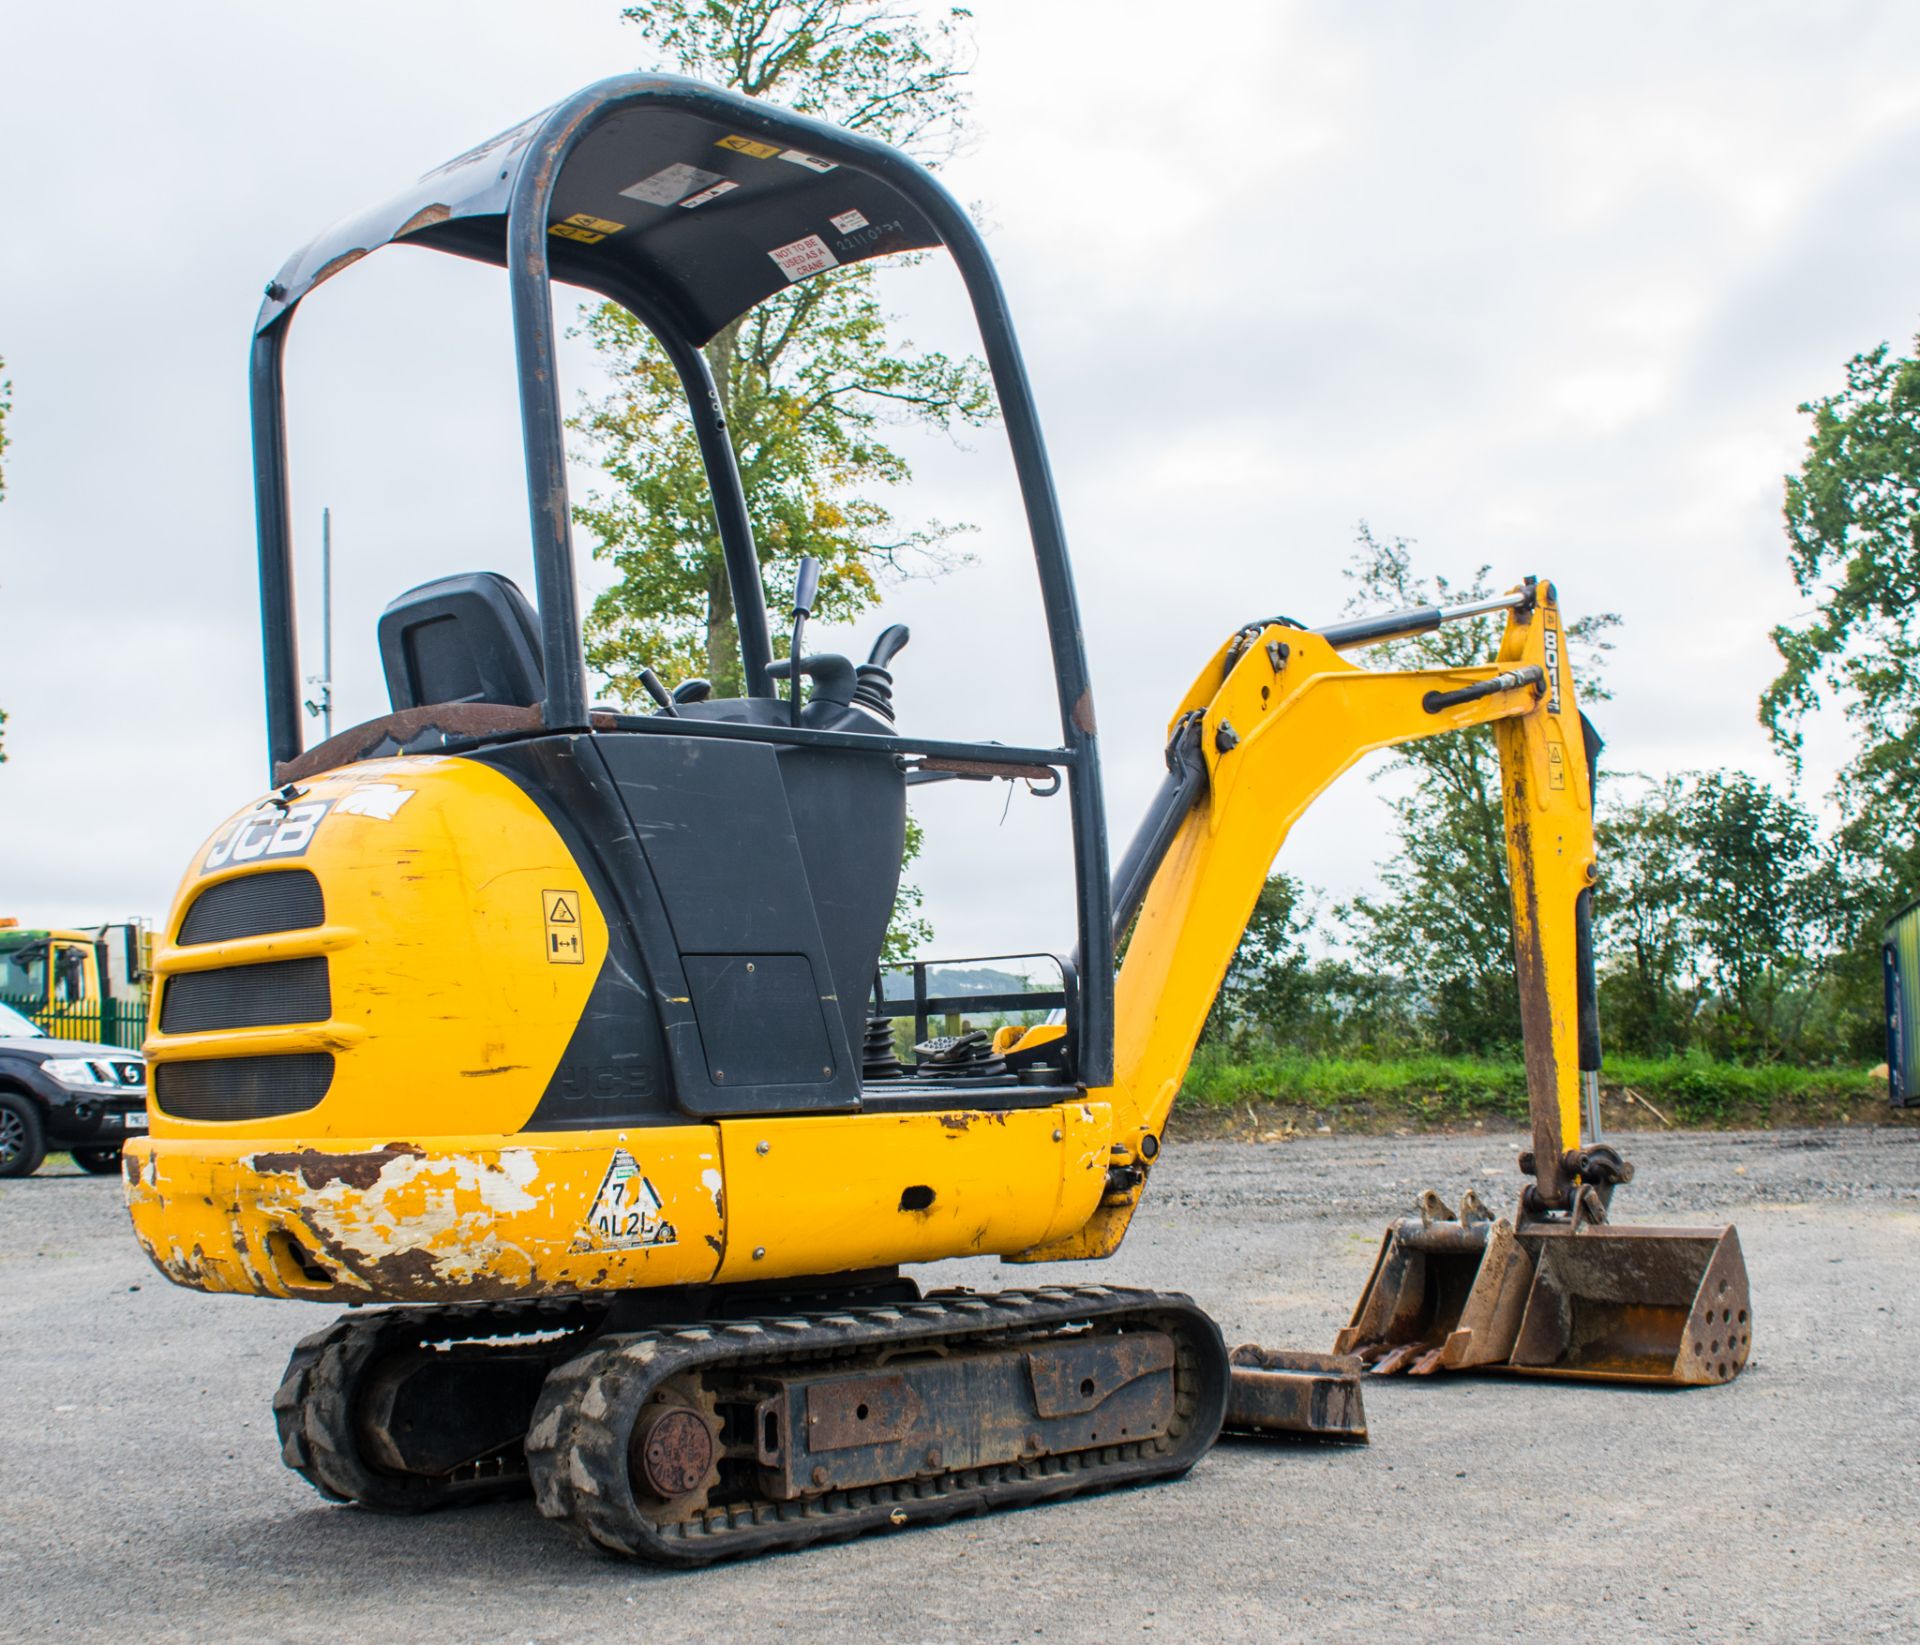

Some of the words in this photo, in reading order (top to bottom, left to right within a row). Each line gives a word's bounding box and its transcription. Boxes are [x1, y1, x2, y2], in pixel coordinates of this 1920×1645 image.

[775, 247, 794, 259] NOT
[793, 243, 805, 254] TO
[805, 238, 818, 248] BE
[782, 256, 806, 269] USED
[806, 250, 820, 261] AS
[796, 260, 826, 276] CRANE
[205, 803, 327, 869] JCB
